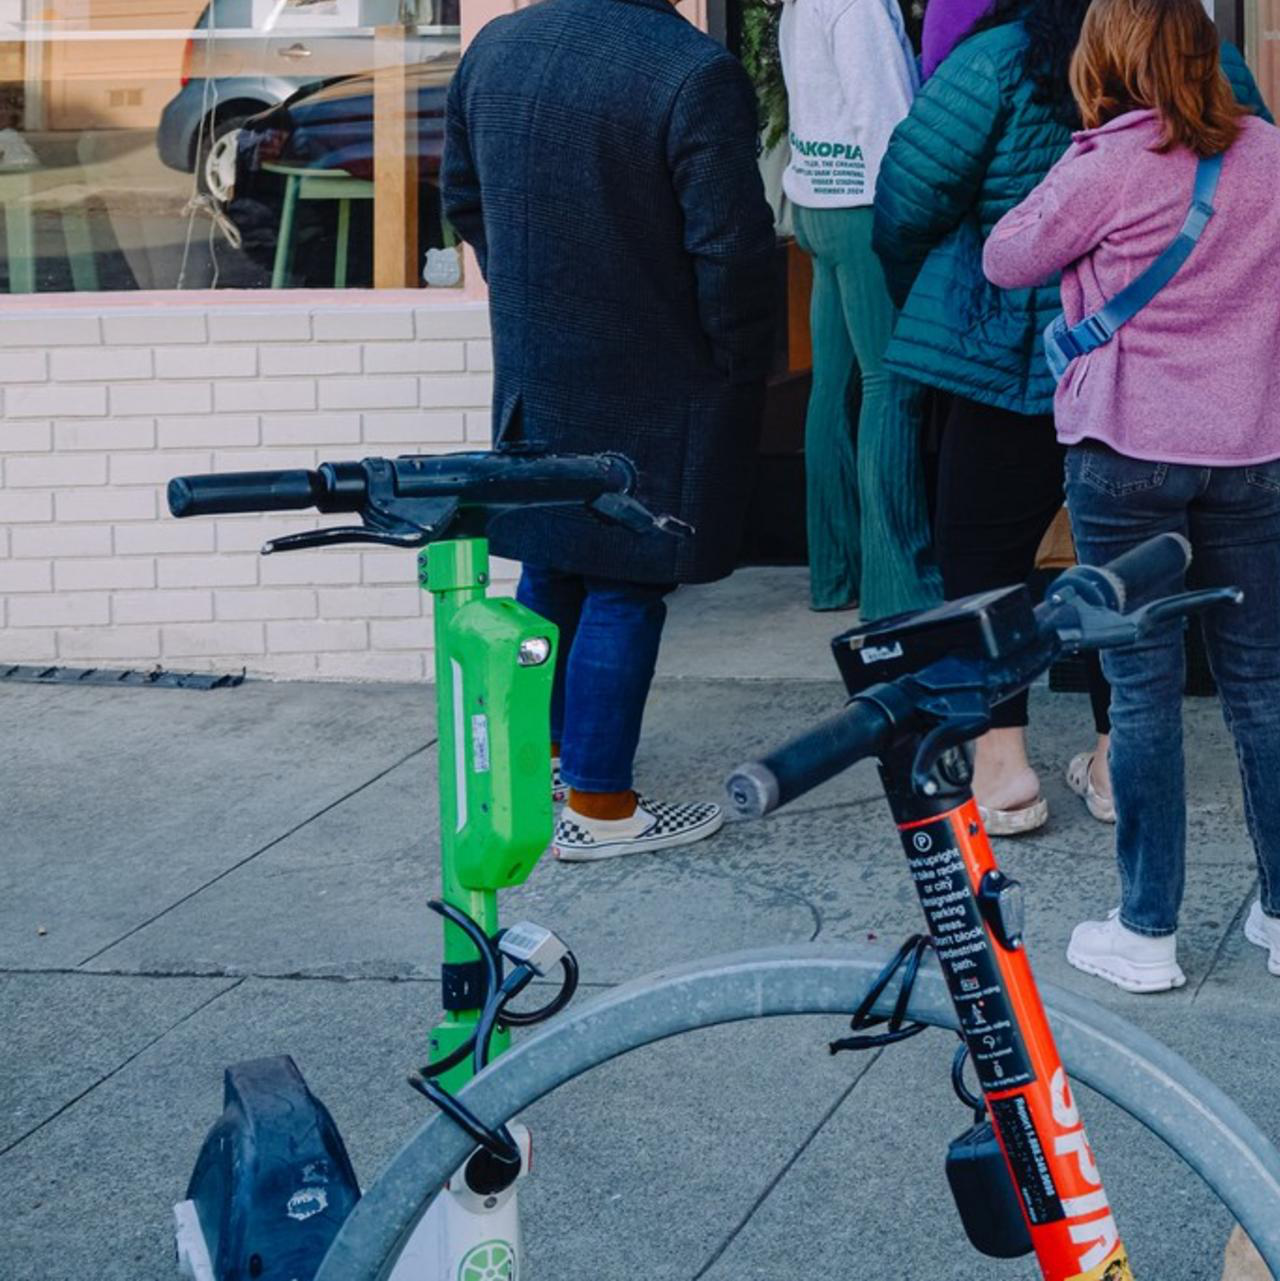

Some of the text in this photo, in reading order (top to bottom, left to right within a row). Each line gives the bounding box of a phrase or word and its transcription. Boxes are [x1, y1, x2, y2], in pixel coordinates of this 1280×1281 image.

[922, 847, 960, 867] upright
[934, 875, 953, 892] city
[953, 925, 984, 943] block
